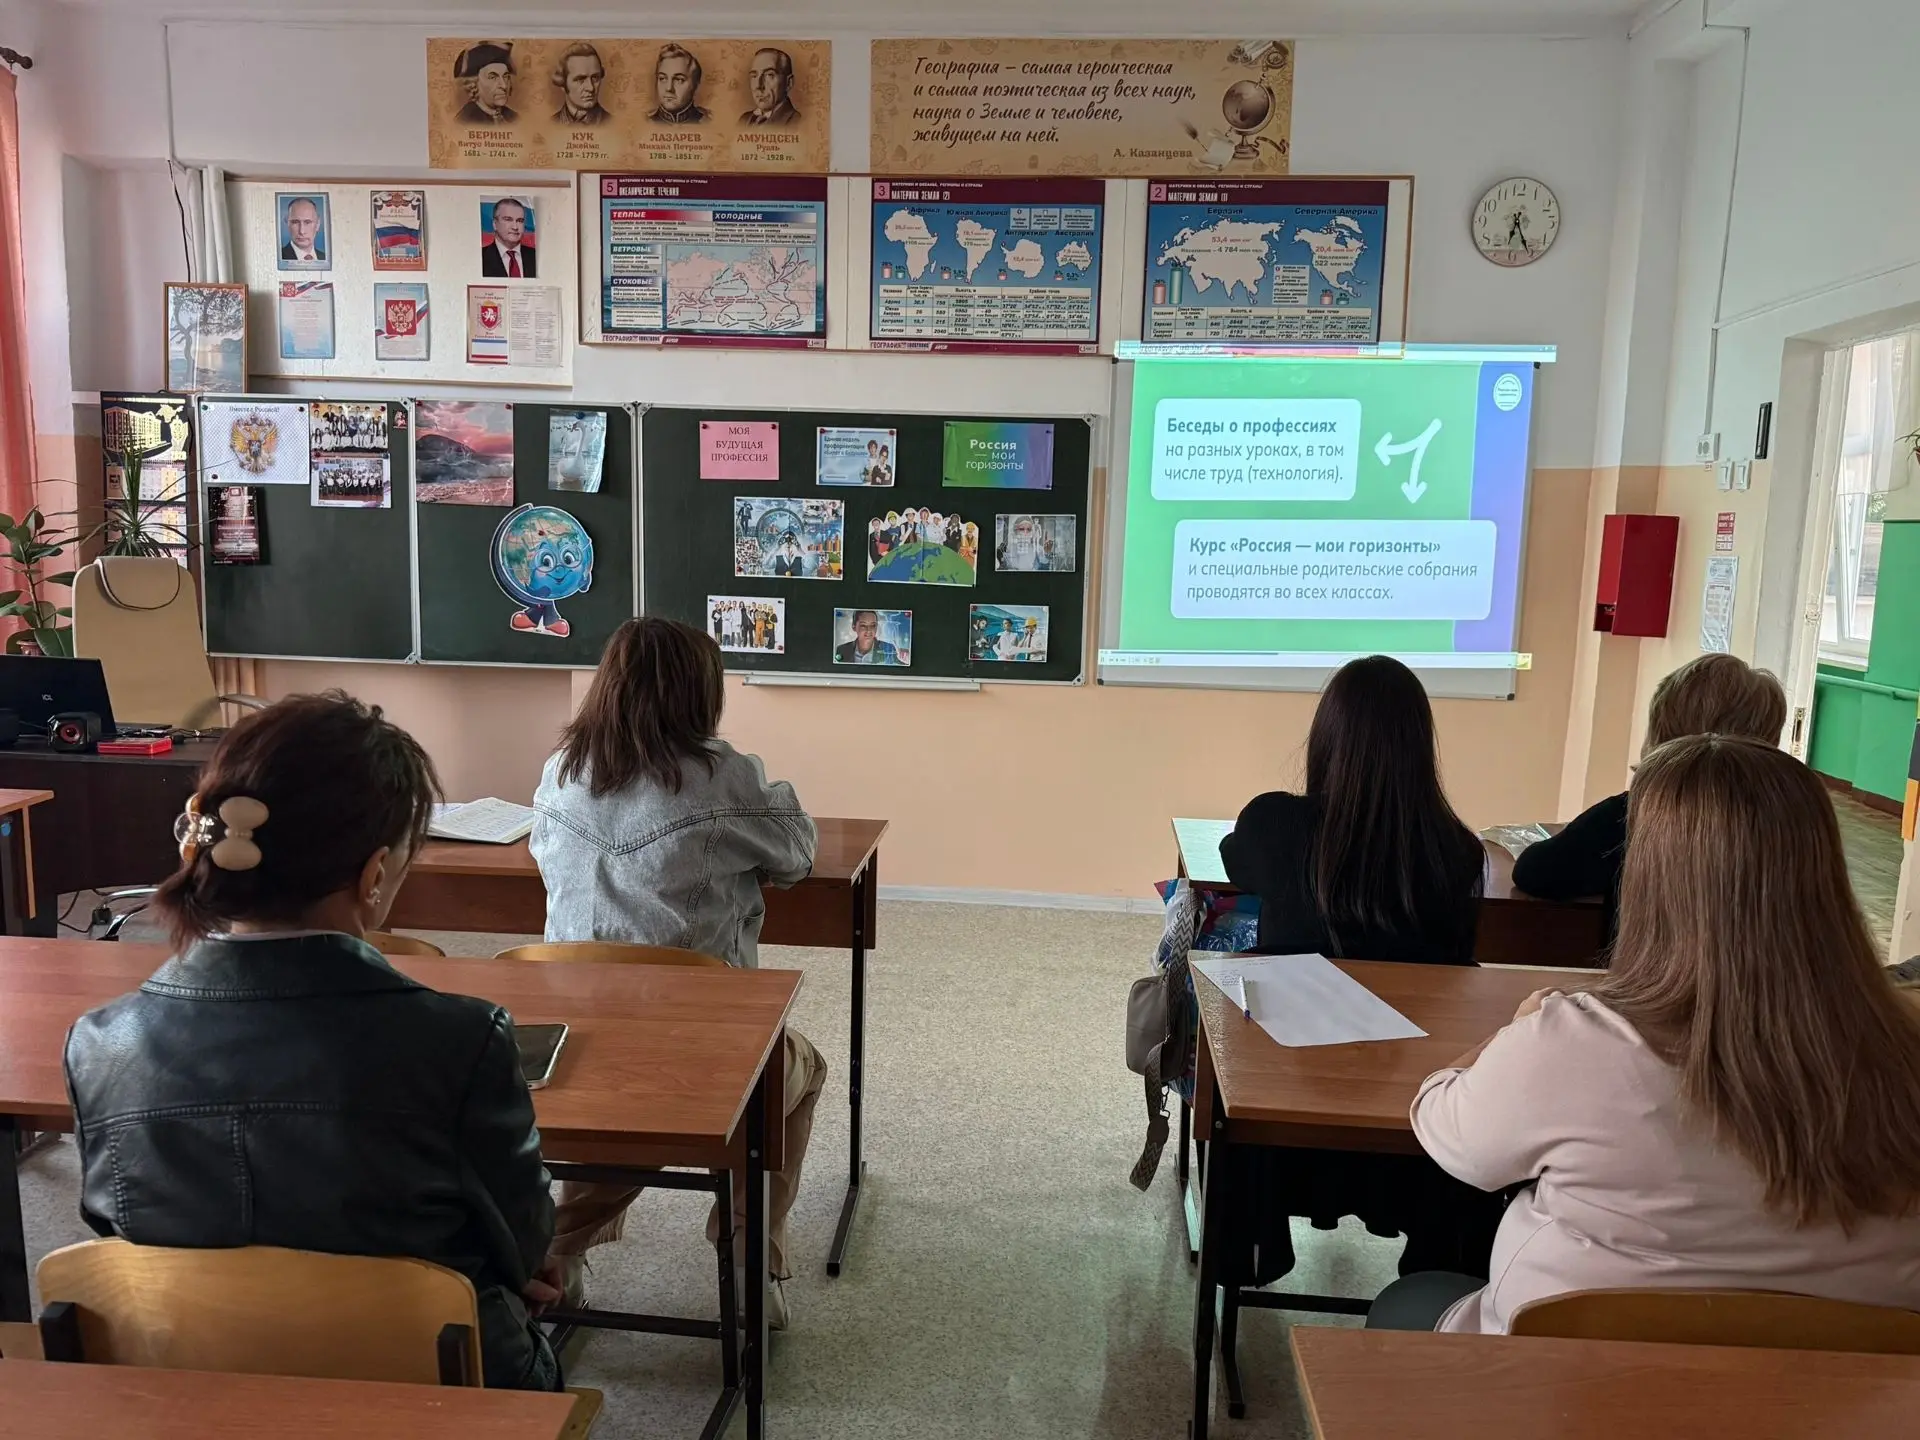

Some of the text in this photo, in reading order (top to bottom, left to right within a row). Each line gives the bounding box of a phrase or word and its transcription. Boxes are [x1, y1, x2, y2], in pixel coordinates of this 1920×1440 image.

[914, 57, 1000, 80] География
[1022, 62, 1072, 74] самая
[1078, 62, 1173, 80] героическая
[914, 79, 1196, 104] и самая поэтическая из всех наук,
[912, 101, 1122, 126] наука о Земле и человеке,
[468, 130, 513, 140] БЕРИНГ
[572, 132, 594, 141] КУК
[650, 133, 702, 142] ЛАЗАРЕВ
[736, 134, 800, 144] АМУНДСЕН
[912, 123, 1058, 148] живущем на ней.
[489, 150, 507, 158] 1741
[675, 152, 692, 160] 1851
[606, 182, 614, 192] 5
[879, 186, 885, 196] 3
[892, 190, 919, 200] МАТЕРИКИ
[1154, 187, 1162, 198] 2
[1168, 192, 1196, 202] МАТЕРИКИ
[1484, 199, 1496, 212] 10
[728, 427, 750, 435] МОЯ
[1168, 418, 1336, 436] Беседы о профессиях
[716, 440, 764, 450] БУДУЩАЯ
[970, 439, 1017, 450] Россия
[992, 452, 1016, 460] мои
[1166, 445, 1344, 460] на разных уроках, в том
[711, 454, 768, 462] ПРОФЕССИЯ
[966, 460, 1024, 472] горизонты
[1164, 465, 1343, 484] числе труд (технология).
[1190, 538, 1226, 556] Курс
[1230, 538, 1292, 552] «Россия
[1316, 541, 1344, 552] мои
[1349, 541, 1441, 556] горизонты»
[1188, 562, 1478, 580] и специальные родительские собрания
[1187, 587, 1394, 602] проводятся во всех классах.
